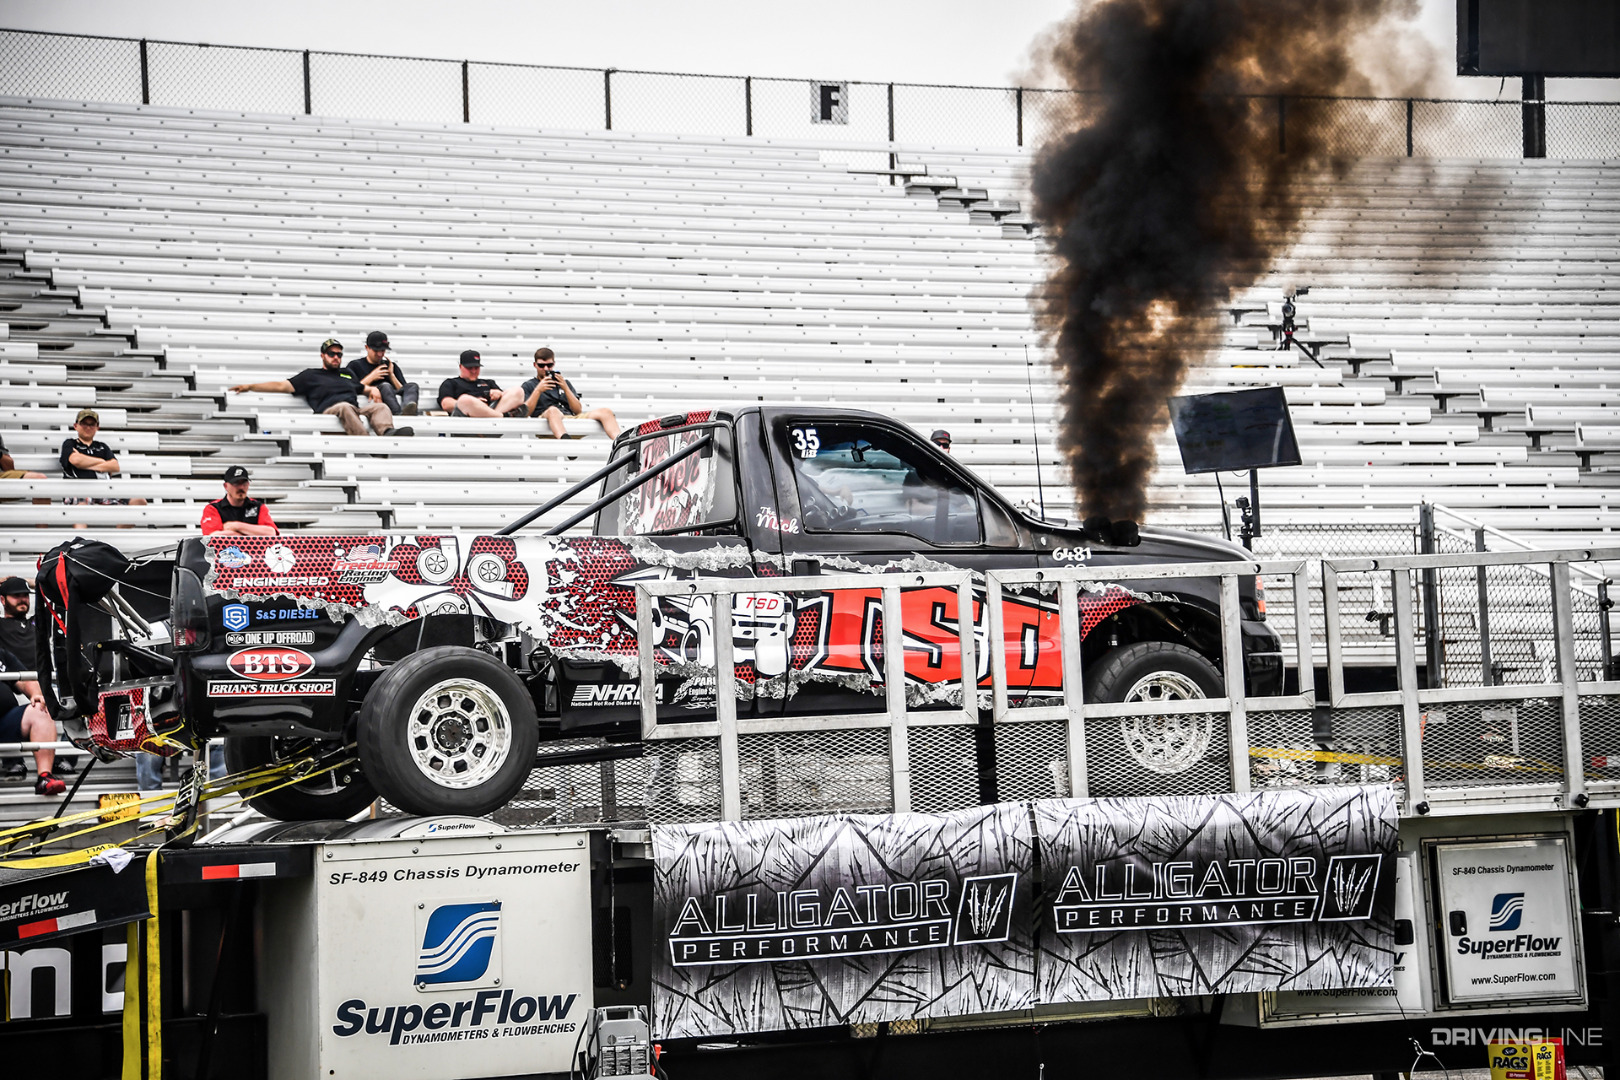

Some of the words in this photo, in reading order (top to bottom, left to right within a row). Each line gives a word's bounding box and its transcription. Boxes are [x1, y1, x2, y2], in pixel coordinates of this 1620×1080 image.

[820, 85, 840, 120] F
[792, 429, 820, 450] 35
[760, 506, 776, 516] The
[756, 513, 799, 534] Mick
[1052, 546, 1092, 561] 6481
[334, 560, 399, 570] Freedom
[233, 577, 329, 587] ENGINEERED
[746, 597, 779, 610] TSD
[255, 609, 277, 620] S&S
[279, 608, 319, 619] DIESEL
[245, 633, 262, 644] ONE
[263, 633, 275, 643] UP
[276, 632, 313, 643] OFFROAD
[243, 653, 300, 674] BTS
[211, 684, 258, 694] BRIAN'S
[259, 683, 298, 693] TRUCK
[438, 823, 476, 831] SuperFlow
[330, 870, 388, 885] SF-849
[393, 866, 460, 881] Chassis
[465, 861, 580, 879] Dynamometer
[1452, 867, 1476, 876] SF-849
[1477, 865, 1504, 874] Chassis
[1506, 862, 1554, 873] Dynamometer
[1055, 856, 1318, 902] ALLIGATOR
[670, 879, 952, 935] ALLIGATOR
[1066, 902, 1306, 926] PERFORMANCE
[683, 926, 940, 959] PERFORMANCE
[1457, 934, 1559, 960] SuperFlow
[1487, 952, 1523, 960] DYNAMOMETERS
[1471, 973, 1556, 985] www.SuperFlow.com
[333, 989, 577, 1045] SuperFlow
[402, 1029, 488, 1045] DYNAMOMETERS
[491, 1028, 499, 1038] &
[502, 1022, 576, 1037] FLOWBENCHES
[1536, 1052, 1552, 1060] RAGS
[1493, 1057, 1529, 1070] RAGS
